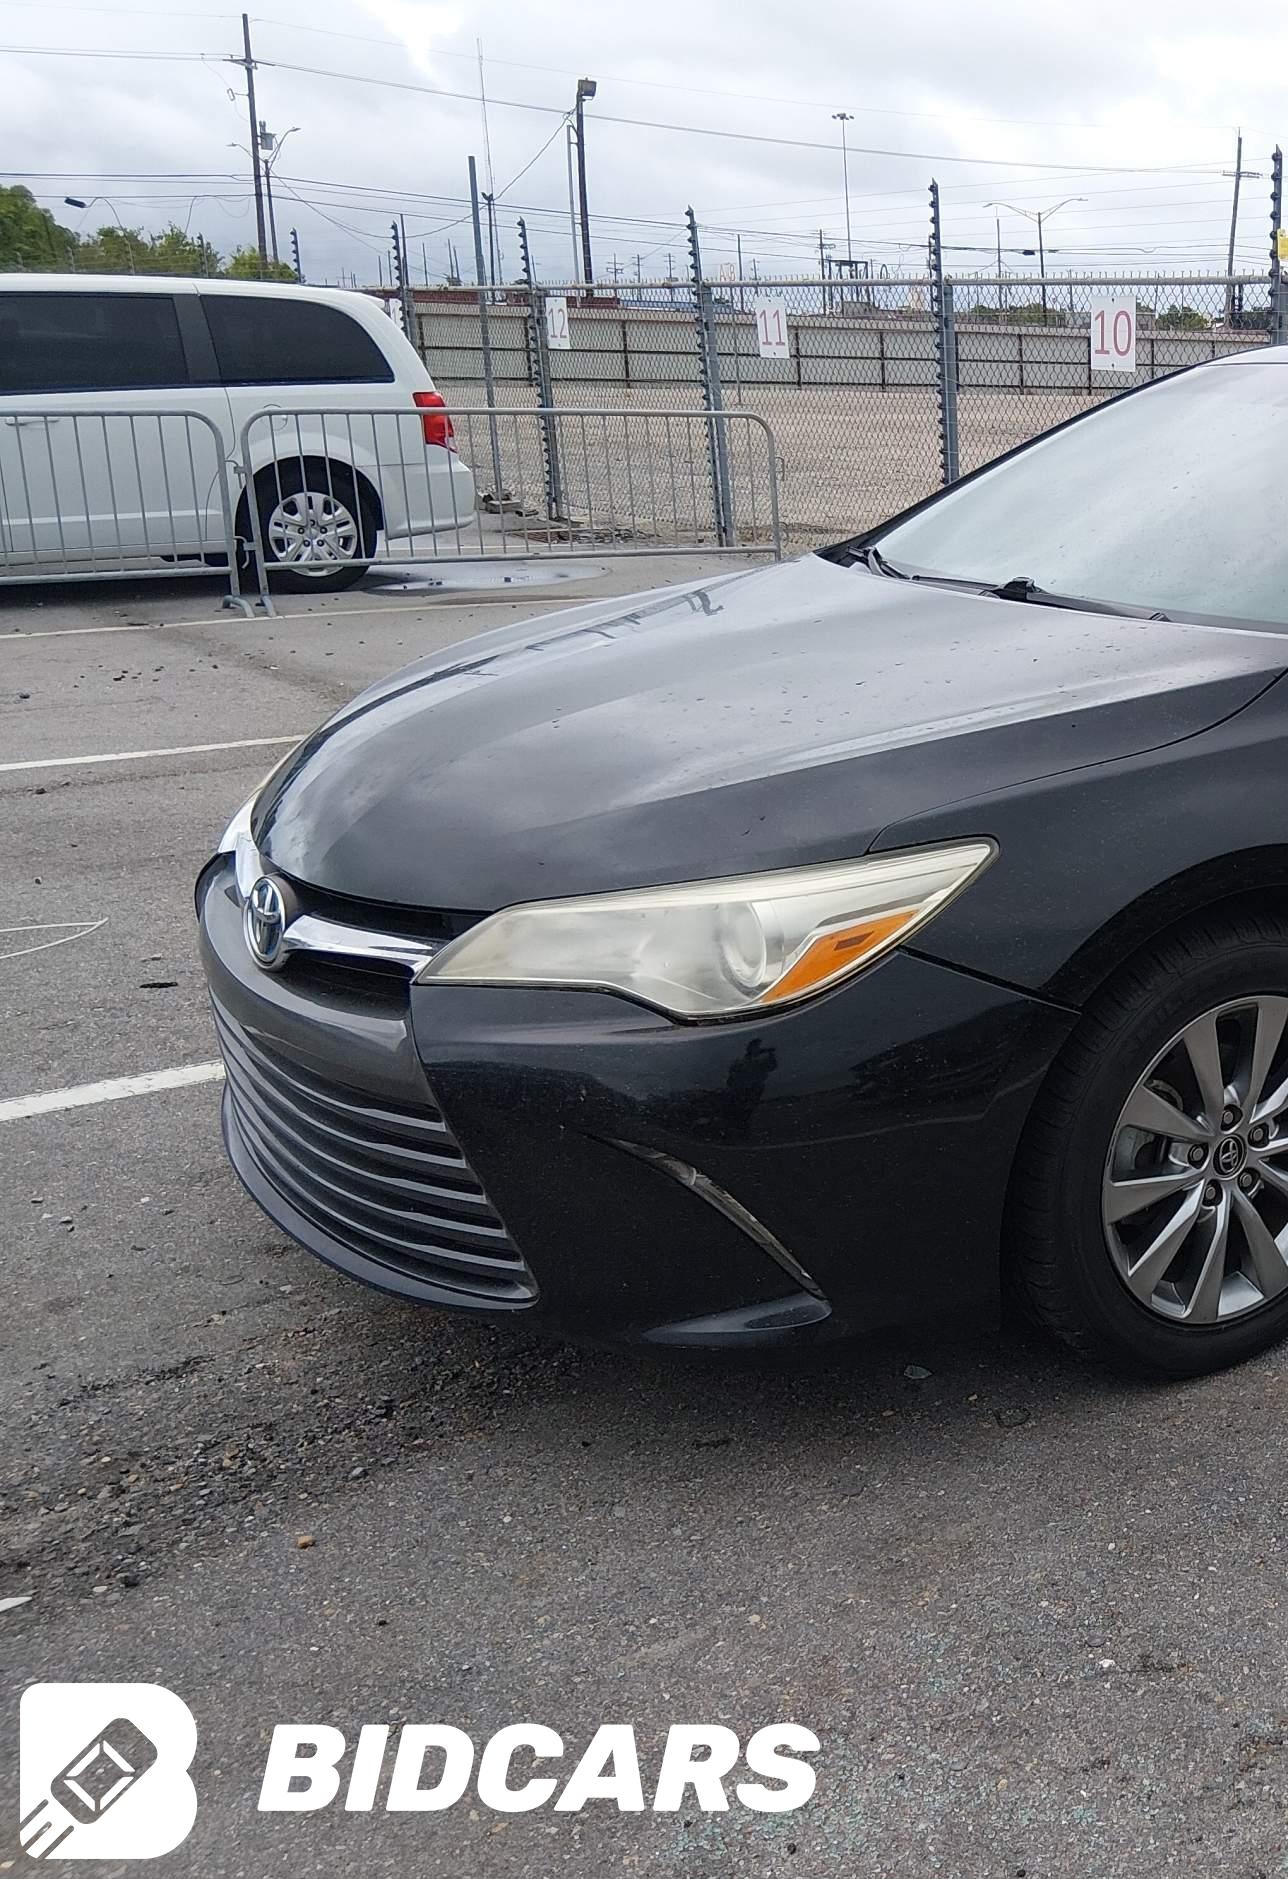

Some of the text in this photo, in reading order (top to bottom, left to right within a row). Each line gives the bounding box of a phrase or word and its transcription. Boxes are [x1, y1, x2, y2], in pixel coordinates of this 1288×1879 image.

[549, 308, 567, 338] 12
[760, 309, 785, 346] 11
[1095, 310, 1132, 357] 10
